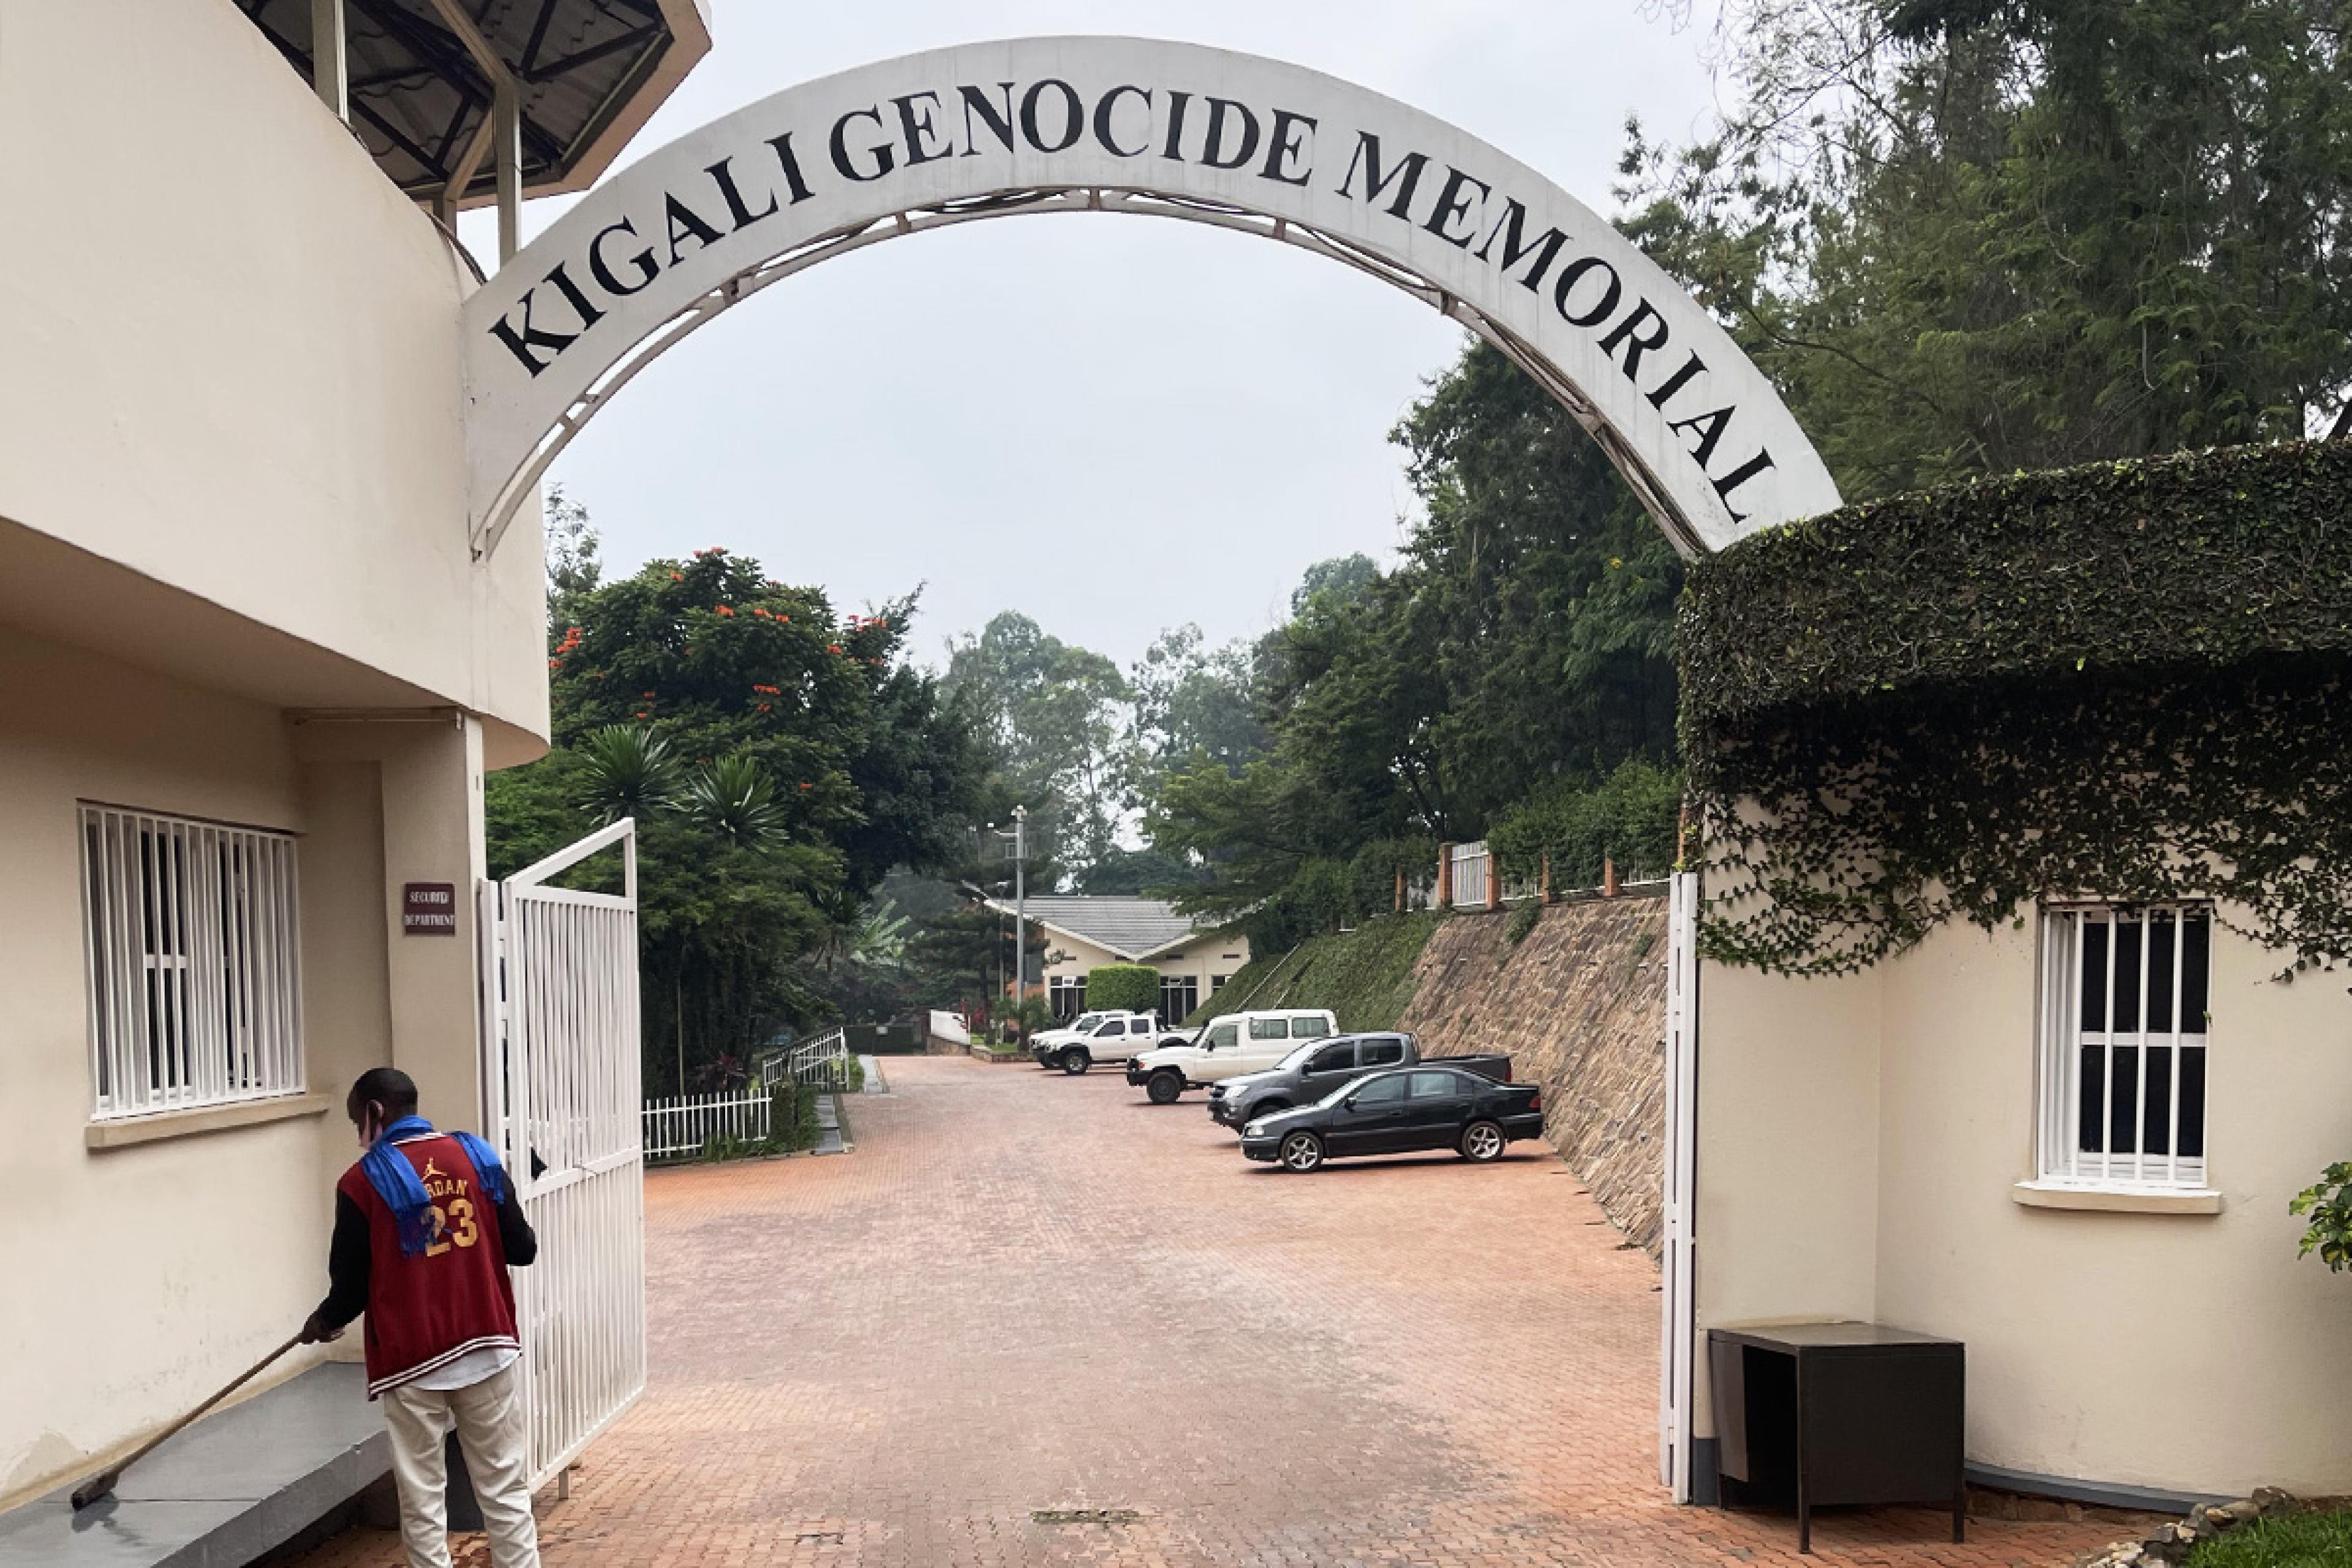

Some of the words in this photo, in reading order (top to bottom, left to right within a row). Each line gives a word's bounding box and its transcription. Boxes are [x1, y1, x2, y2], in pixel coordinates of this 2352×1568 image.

[488, 130, 816, 379] KIGALI
[829, 78, 1318, 187] GENOCIDE
[1334, 129, 1777, 525] MEMORIAL
[405, 914, 454, 926] DEPARTMENT
[424, 1179, 467, 1197] RDAN
[421, 1198, 478, 1257] 23
